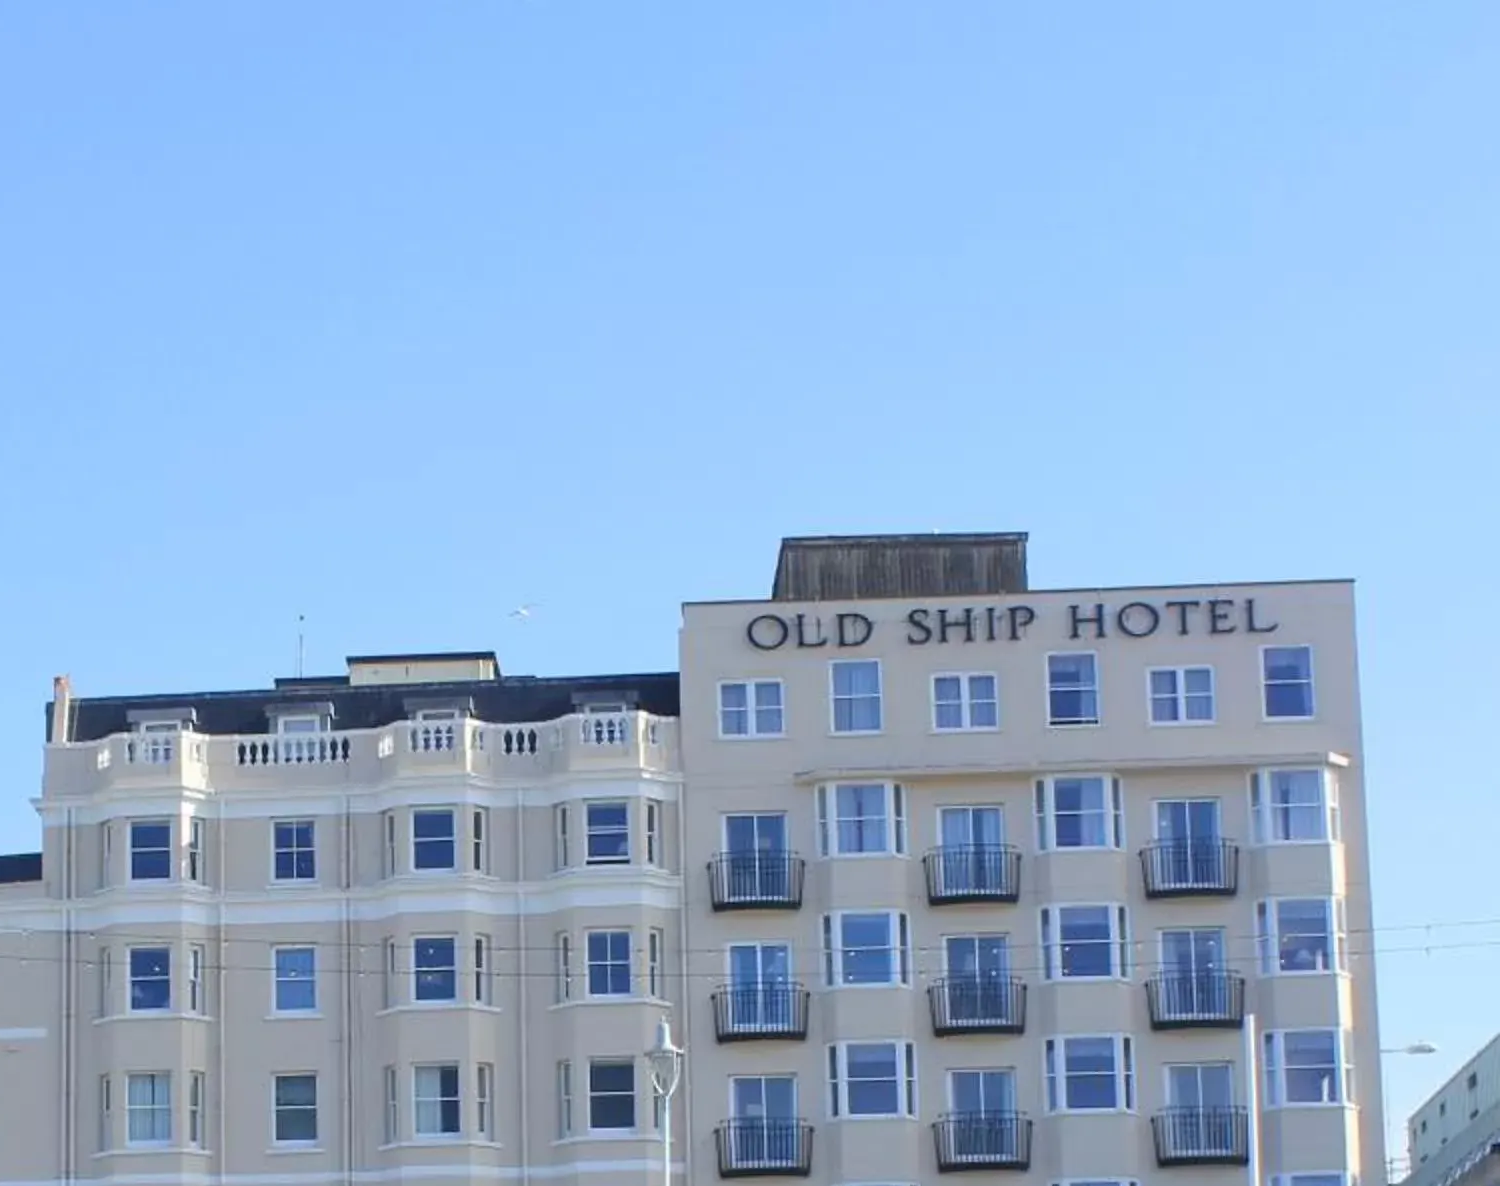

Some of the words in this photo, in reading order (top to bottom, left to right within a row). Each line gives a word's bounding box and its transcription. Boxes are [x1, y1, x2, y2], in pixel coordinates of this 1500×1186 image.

[747, 613, 873, 650] OLD
[907, 605, 1036, 645] SHIP
[1068, 598, 1279, 639] HOTEL
